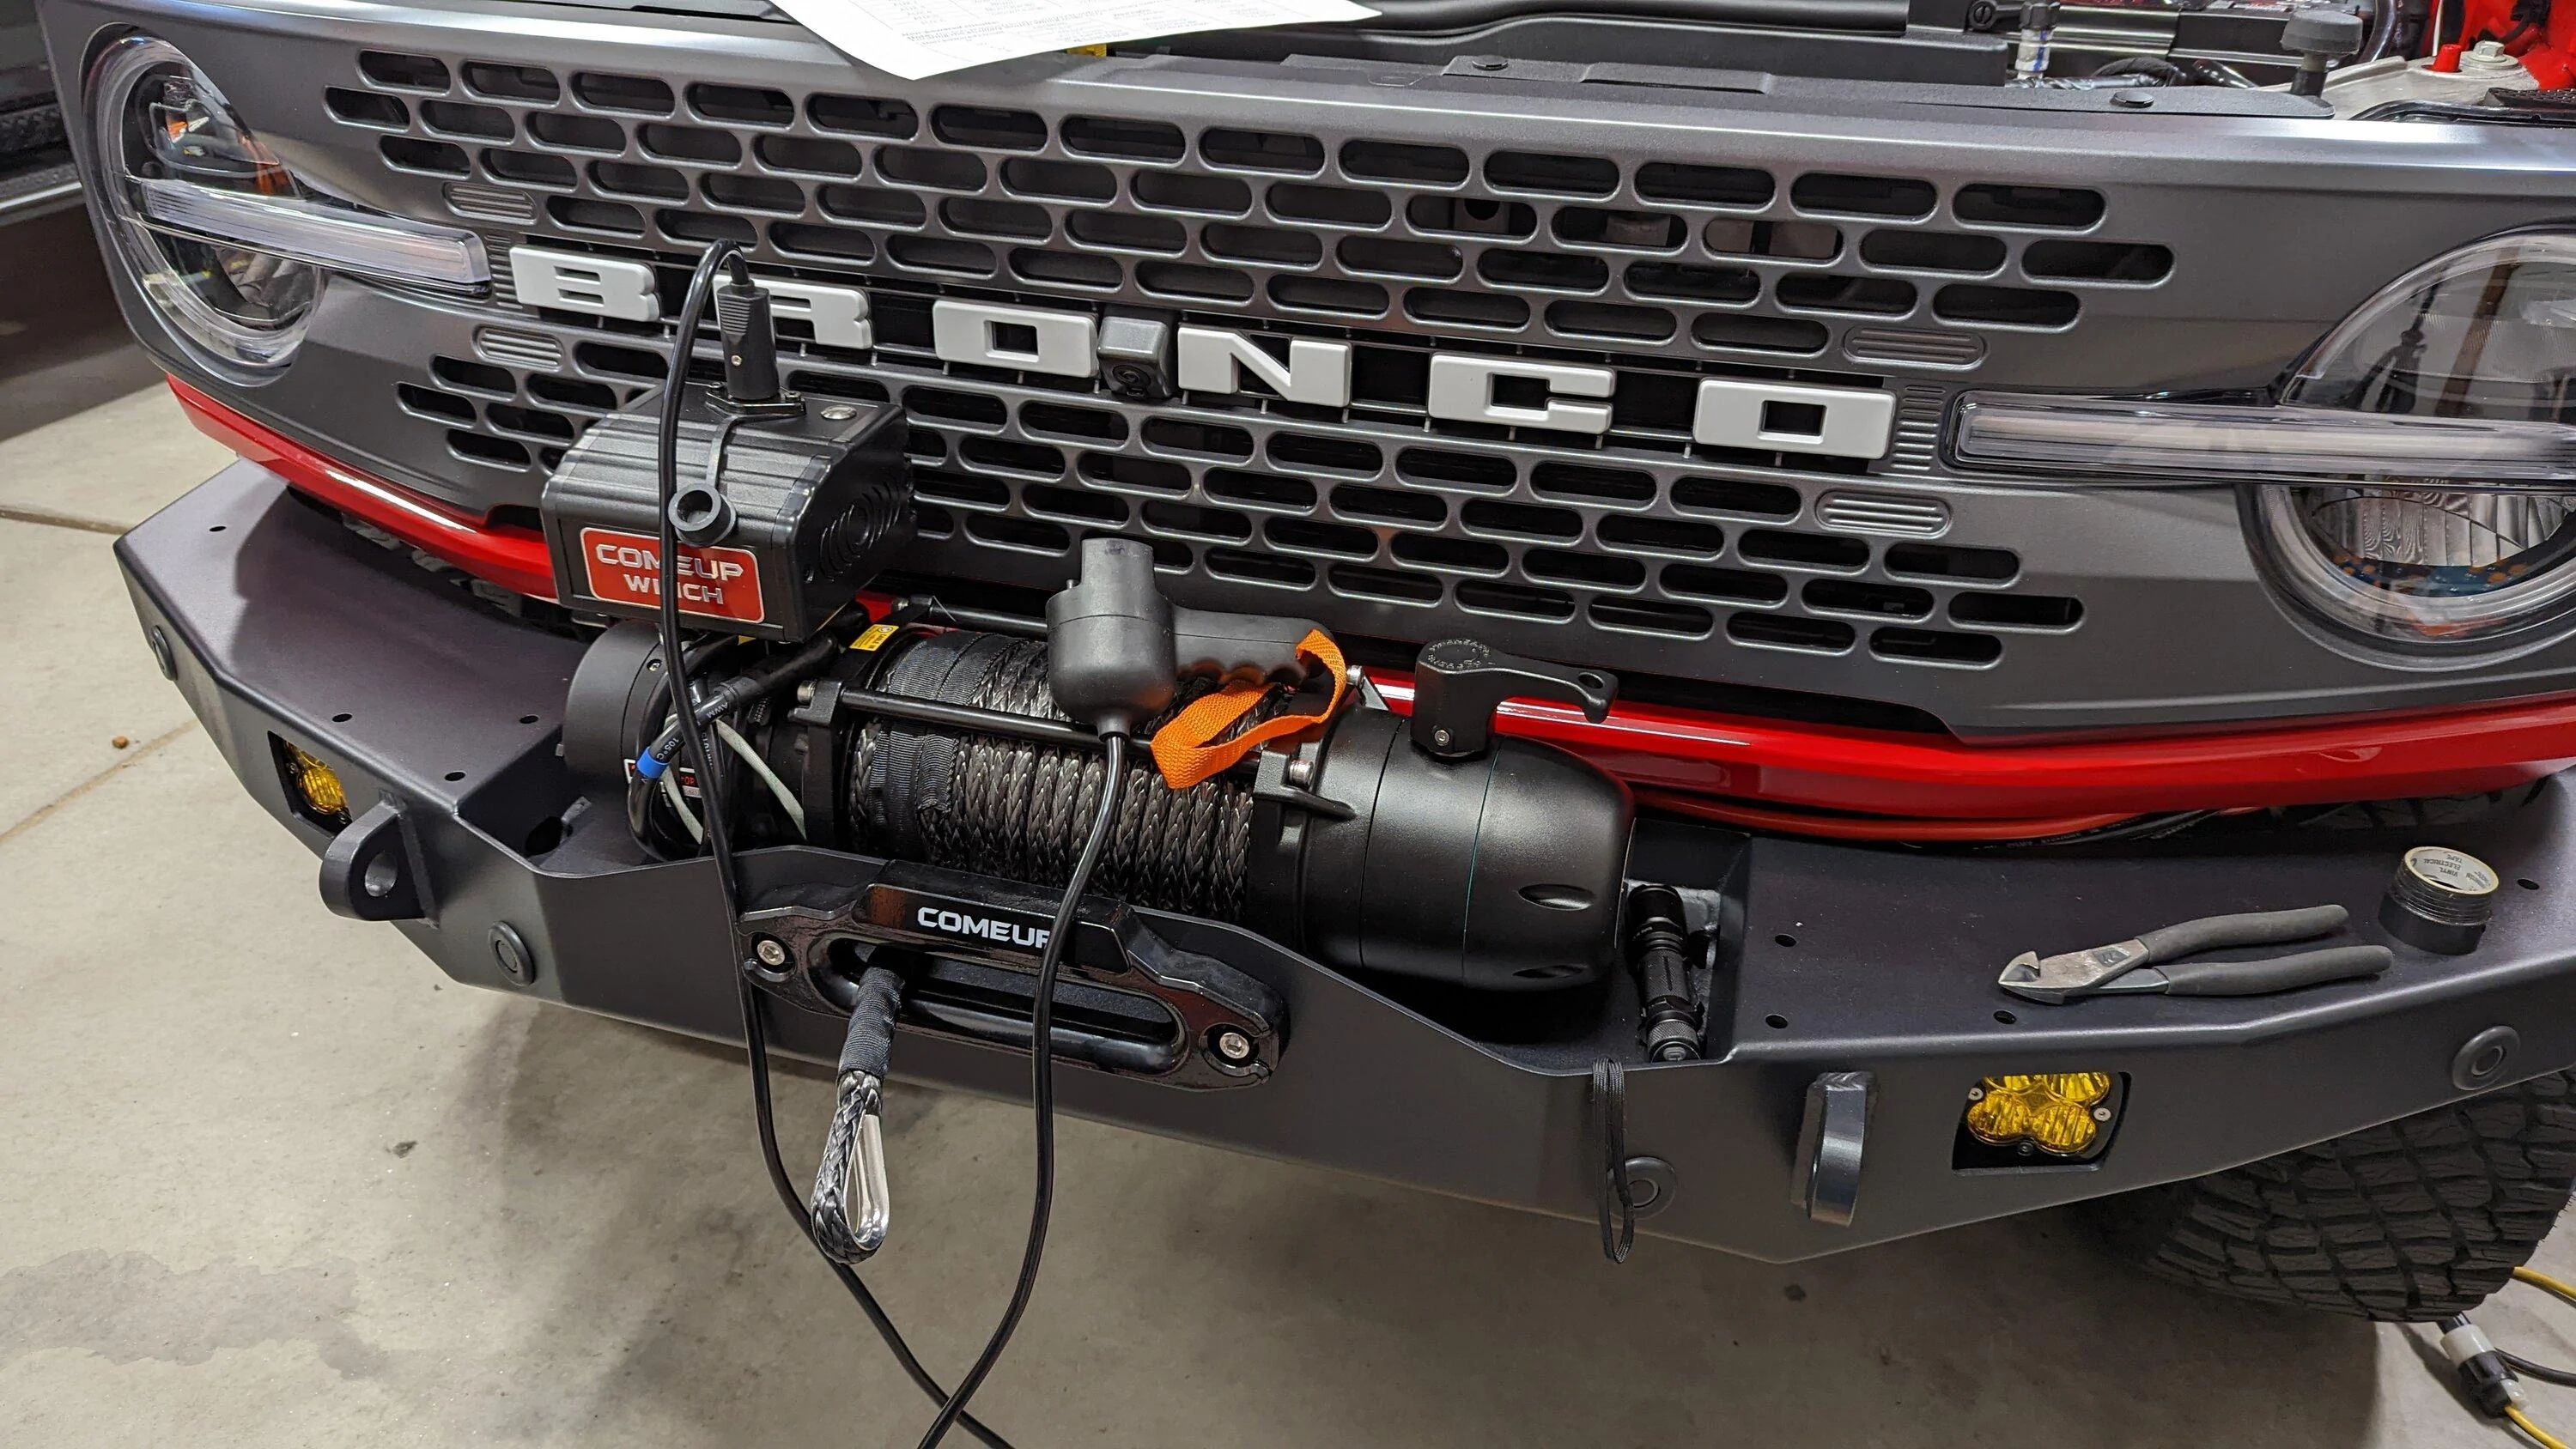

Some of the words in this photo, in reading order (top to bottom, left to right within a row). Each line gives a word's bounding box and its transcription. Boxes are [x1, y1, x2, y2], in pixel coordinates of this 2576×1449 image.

[509, 246, 1896, 459] BRONCO
[595, 543, 744, 581] COMEUP
[623, 573, 724, 605] WICH
[706, 701, 729, 719] AWM
[2422, 858, 2462, 870] ELECTRICAL
[2445, 854, 2463, 864] TAPE
[2438, 866, 2459, 877] VINYL
